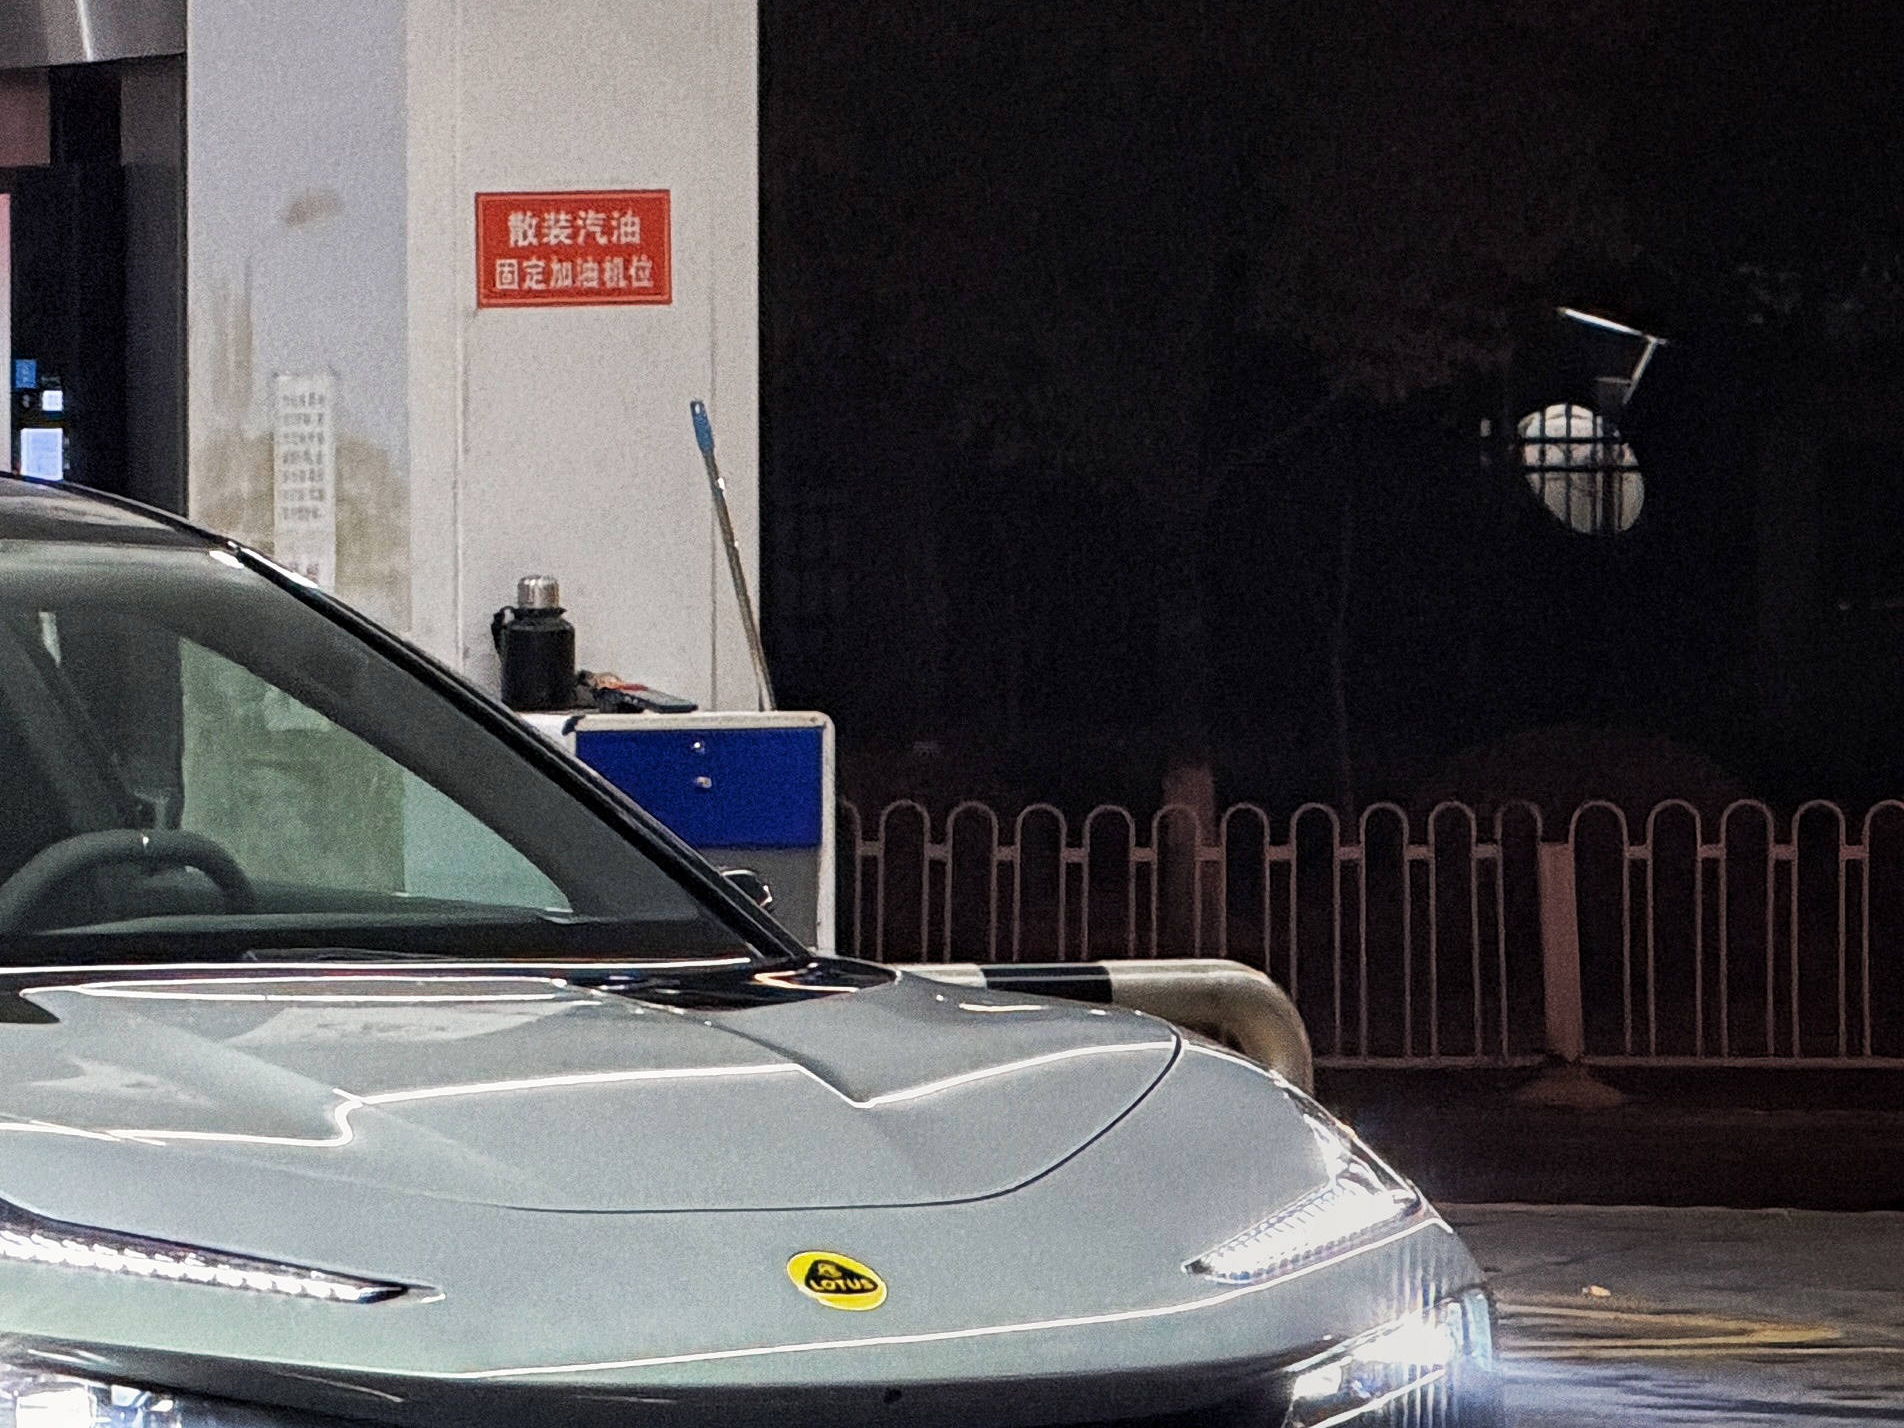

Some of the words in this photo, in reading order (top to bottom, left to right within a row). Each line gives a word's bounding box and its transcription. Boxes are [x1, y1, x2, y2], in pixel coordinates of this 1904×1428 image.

[507, 208, 642, 248] 散装汽油
[495, 254, 654, 291] 固定加油机位
[809, 1277, 876, 1292] LOTUS
